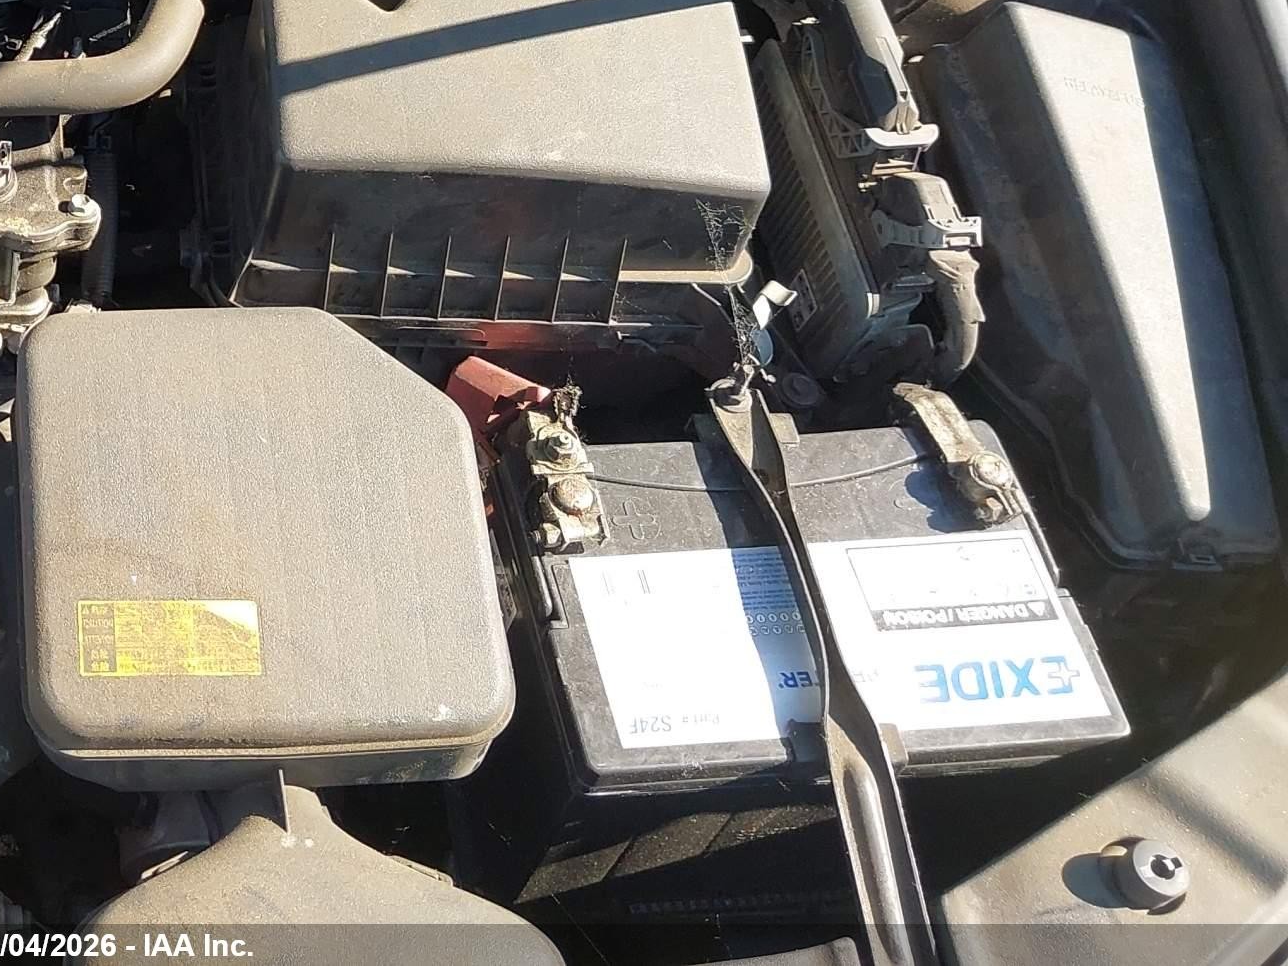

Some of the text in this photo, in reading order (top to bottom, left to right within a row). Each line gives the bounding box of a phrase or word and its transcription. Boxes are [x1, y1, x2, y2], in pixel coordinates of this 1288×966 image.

[955, 604, 1029, 622] DANGER
[915, 655, 1080, 704] EXIDE
[628, 714, 672, 735] S24F
